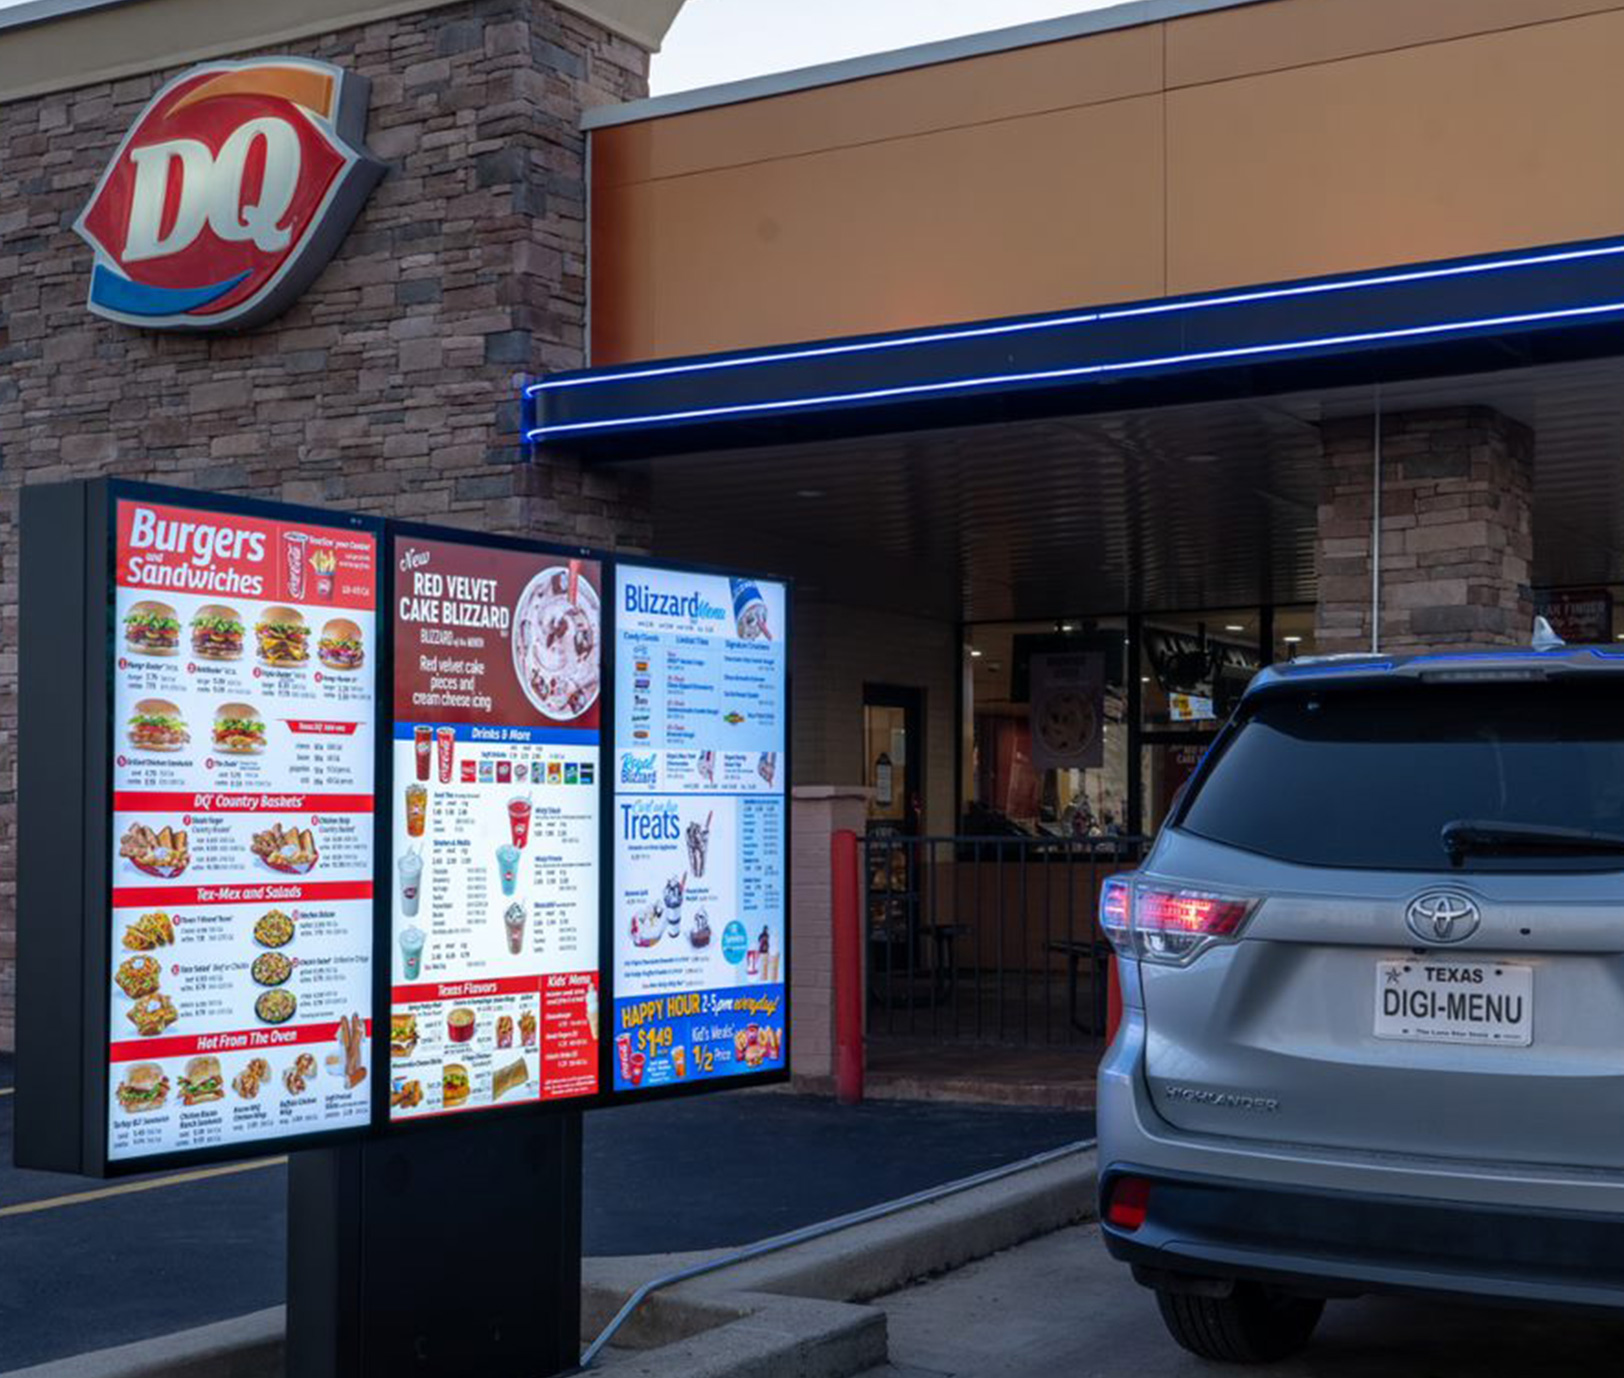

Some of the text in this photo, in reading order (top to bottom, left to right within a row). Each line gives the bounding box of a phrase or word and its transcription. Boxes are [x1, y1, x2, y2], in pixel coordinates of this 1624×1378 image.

[121, 117, 300, 262] DQ
[129, 508, 266, 565] Burgers
[146, 553, 163, 562] and
[400, 548, 430, 571] New
[127, 556, 264, 595] Sandwiches
[414, 572, 497, 602] RED VELVET
[625, 584, 699, 617] Blizzard
[400, 597, 509, 629] CAKE BLIZZARD
[420, 655, 485, 675] Red velvet cake
[431, 672, 475, 691] pieces and
[413, 690, 492, 712] cream cheese icing
[471, 727, 500, 739] Drinks
[509, 729, 531, 741] More
[215, 794, 259, 810] Country
[260, 794, 303, 809] Baskets
[621, 803, 680, 840] Treats
[196, 884, 302, 901] Tex-Mex and Salads
[1424, 966, 1484, 984] TEXAS
[438, 982, 497, 996] Texas Flavors
[621, 999, 664, 1028] HAPPY
[667, 993, 700, 1018] HOUR
[1383, 988, 1522, 1024] DIGI-MENU
[197, 1029, 298, 1050] Hot From The Oven
